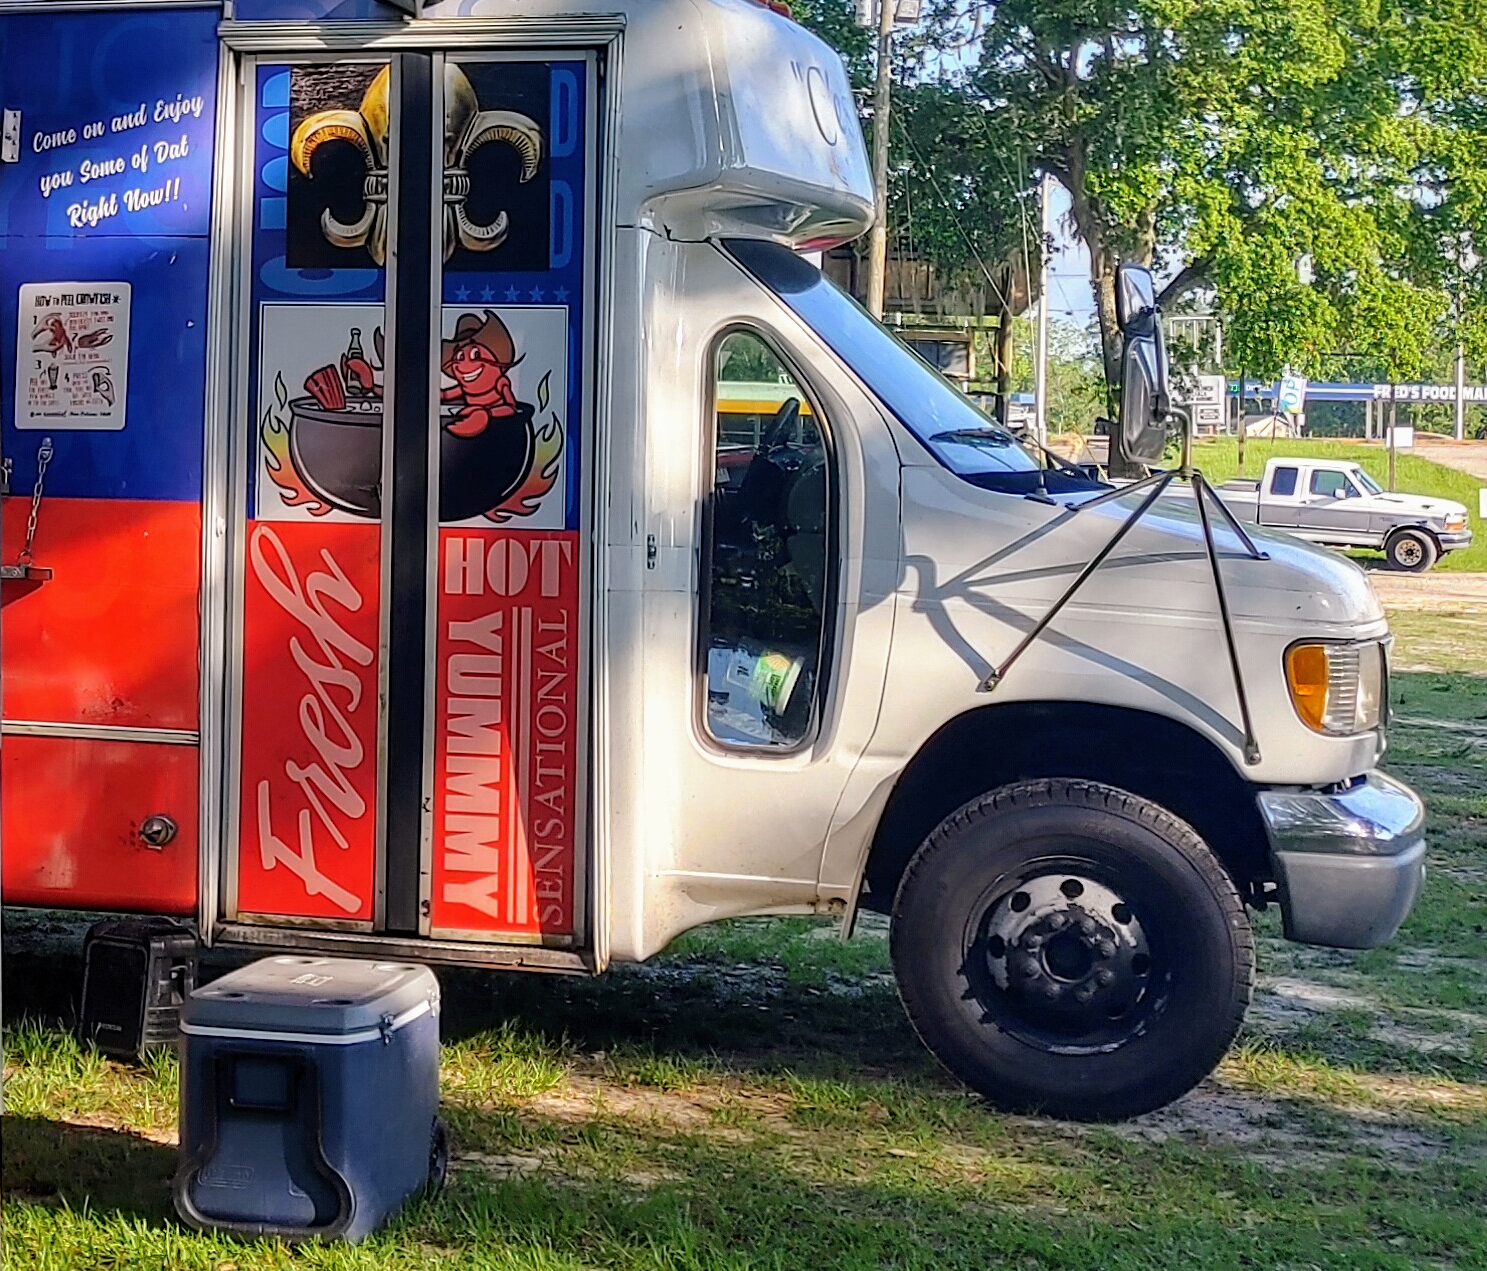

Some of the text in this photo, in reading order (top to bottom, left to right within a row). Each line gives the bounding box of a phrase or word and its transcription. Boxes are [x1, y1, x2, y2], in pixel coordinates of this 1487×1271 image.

[33, 93, 204, 153] Come on and Enjoy
[40, 134, 190, 198] you Some of Dat
[66, 177, 181, 229] Right Now!!
[34, 359, 42, 370] 3
[1374, 384, 1420, 400] FRED'S
[444, 537, 572, 597] HOT
[250, 525, 374, 913] Fresh
[443, 610, 503, 919] YUMMY
[533, 608, 569, 926] SENSATIONAL
